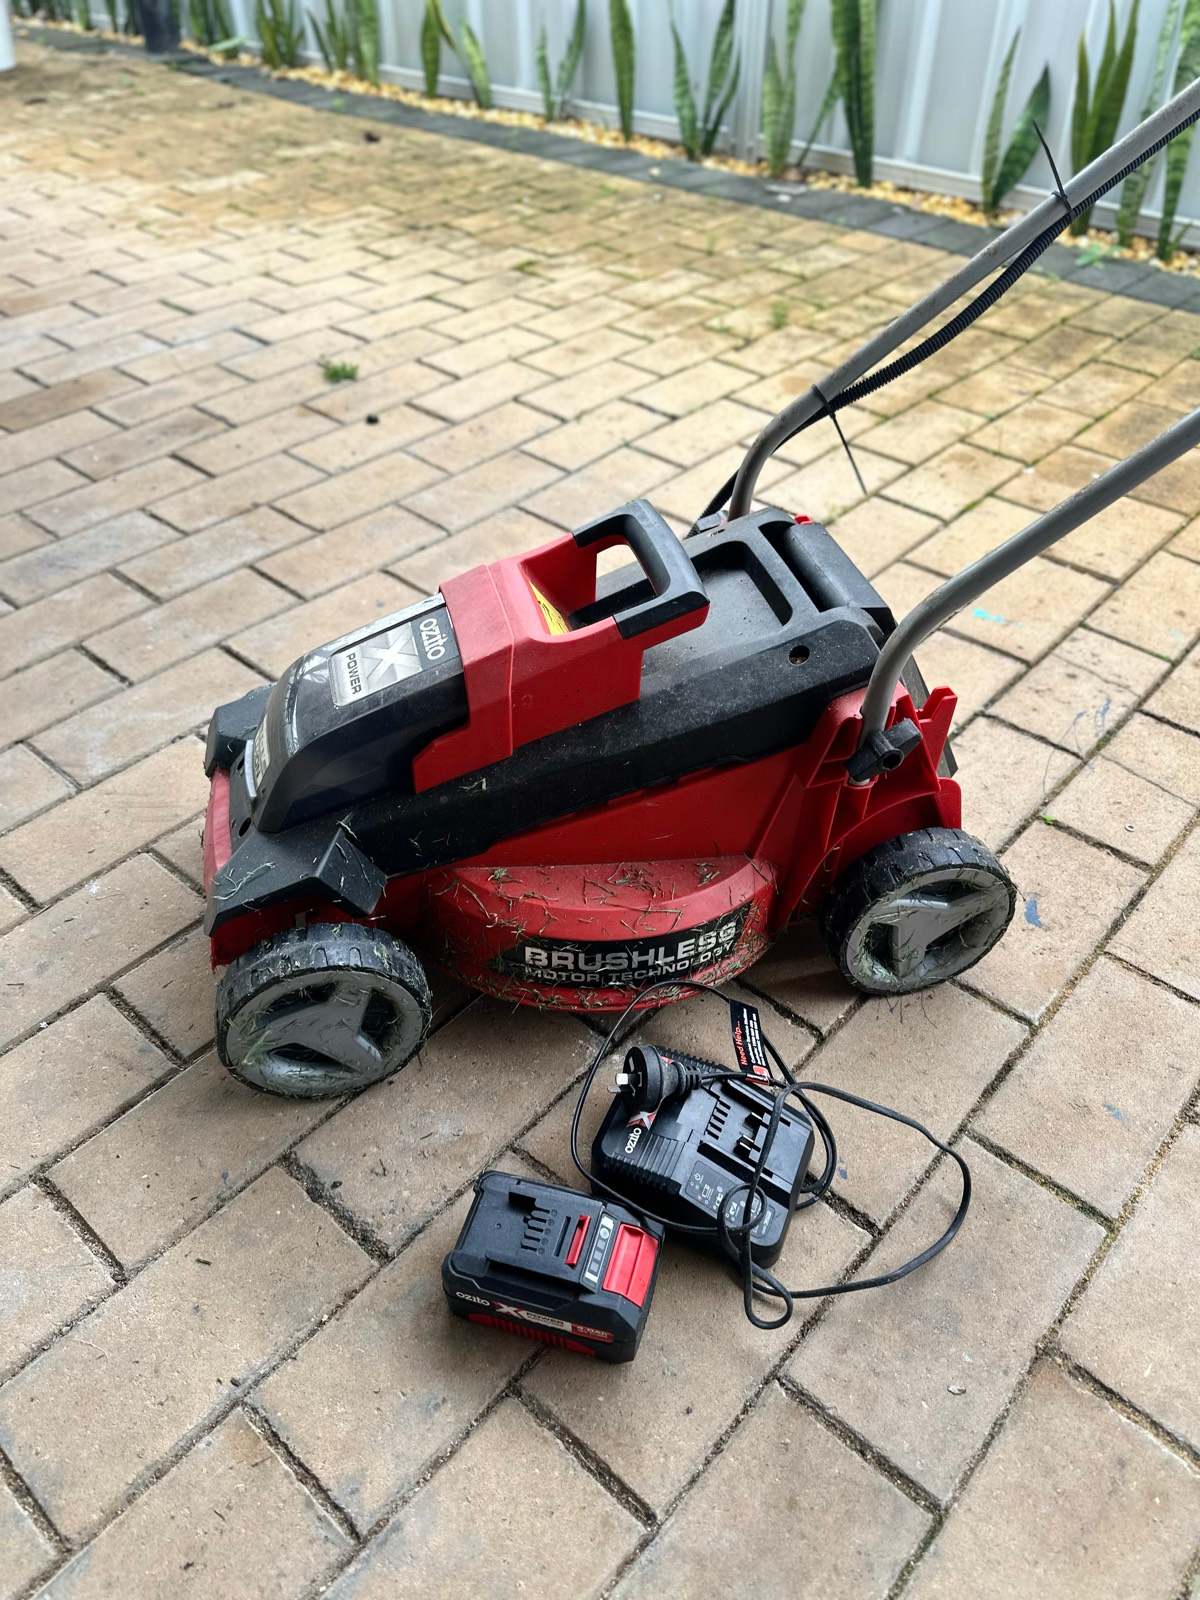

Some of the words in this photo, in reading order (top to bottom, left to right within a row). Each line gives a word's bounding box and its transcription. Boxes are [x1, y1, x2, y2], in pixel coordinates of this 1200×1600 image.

[420, 618, 446, 660] ozito
[346, 652, 362, 695] POWER
[525, 921, 737, 971] BRUSHLESS
[525, 967, 600, 982] MOTOR
[736, 1046, 748, 1066] Need
[625, 1128, 642, 1153] ozito
[456, 1291, 490, 1307] ozito
